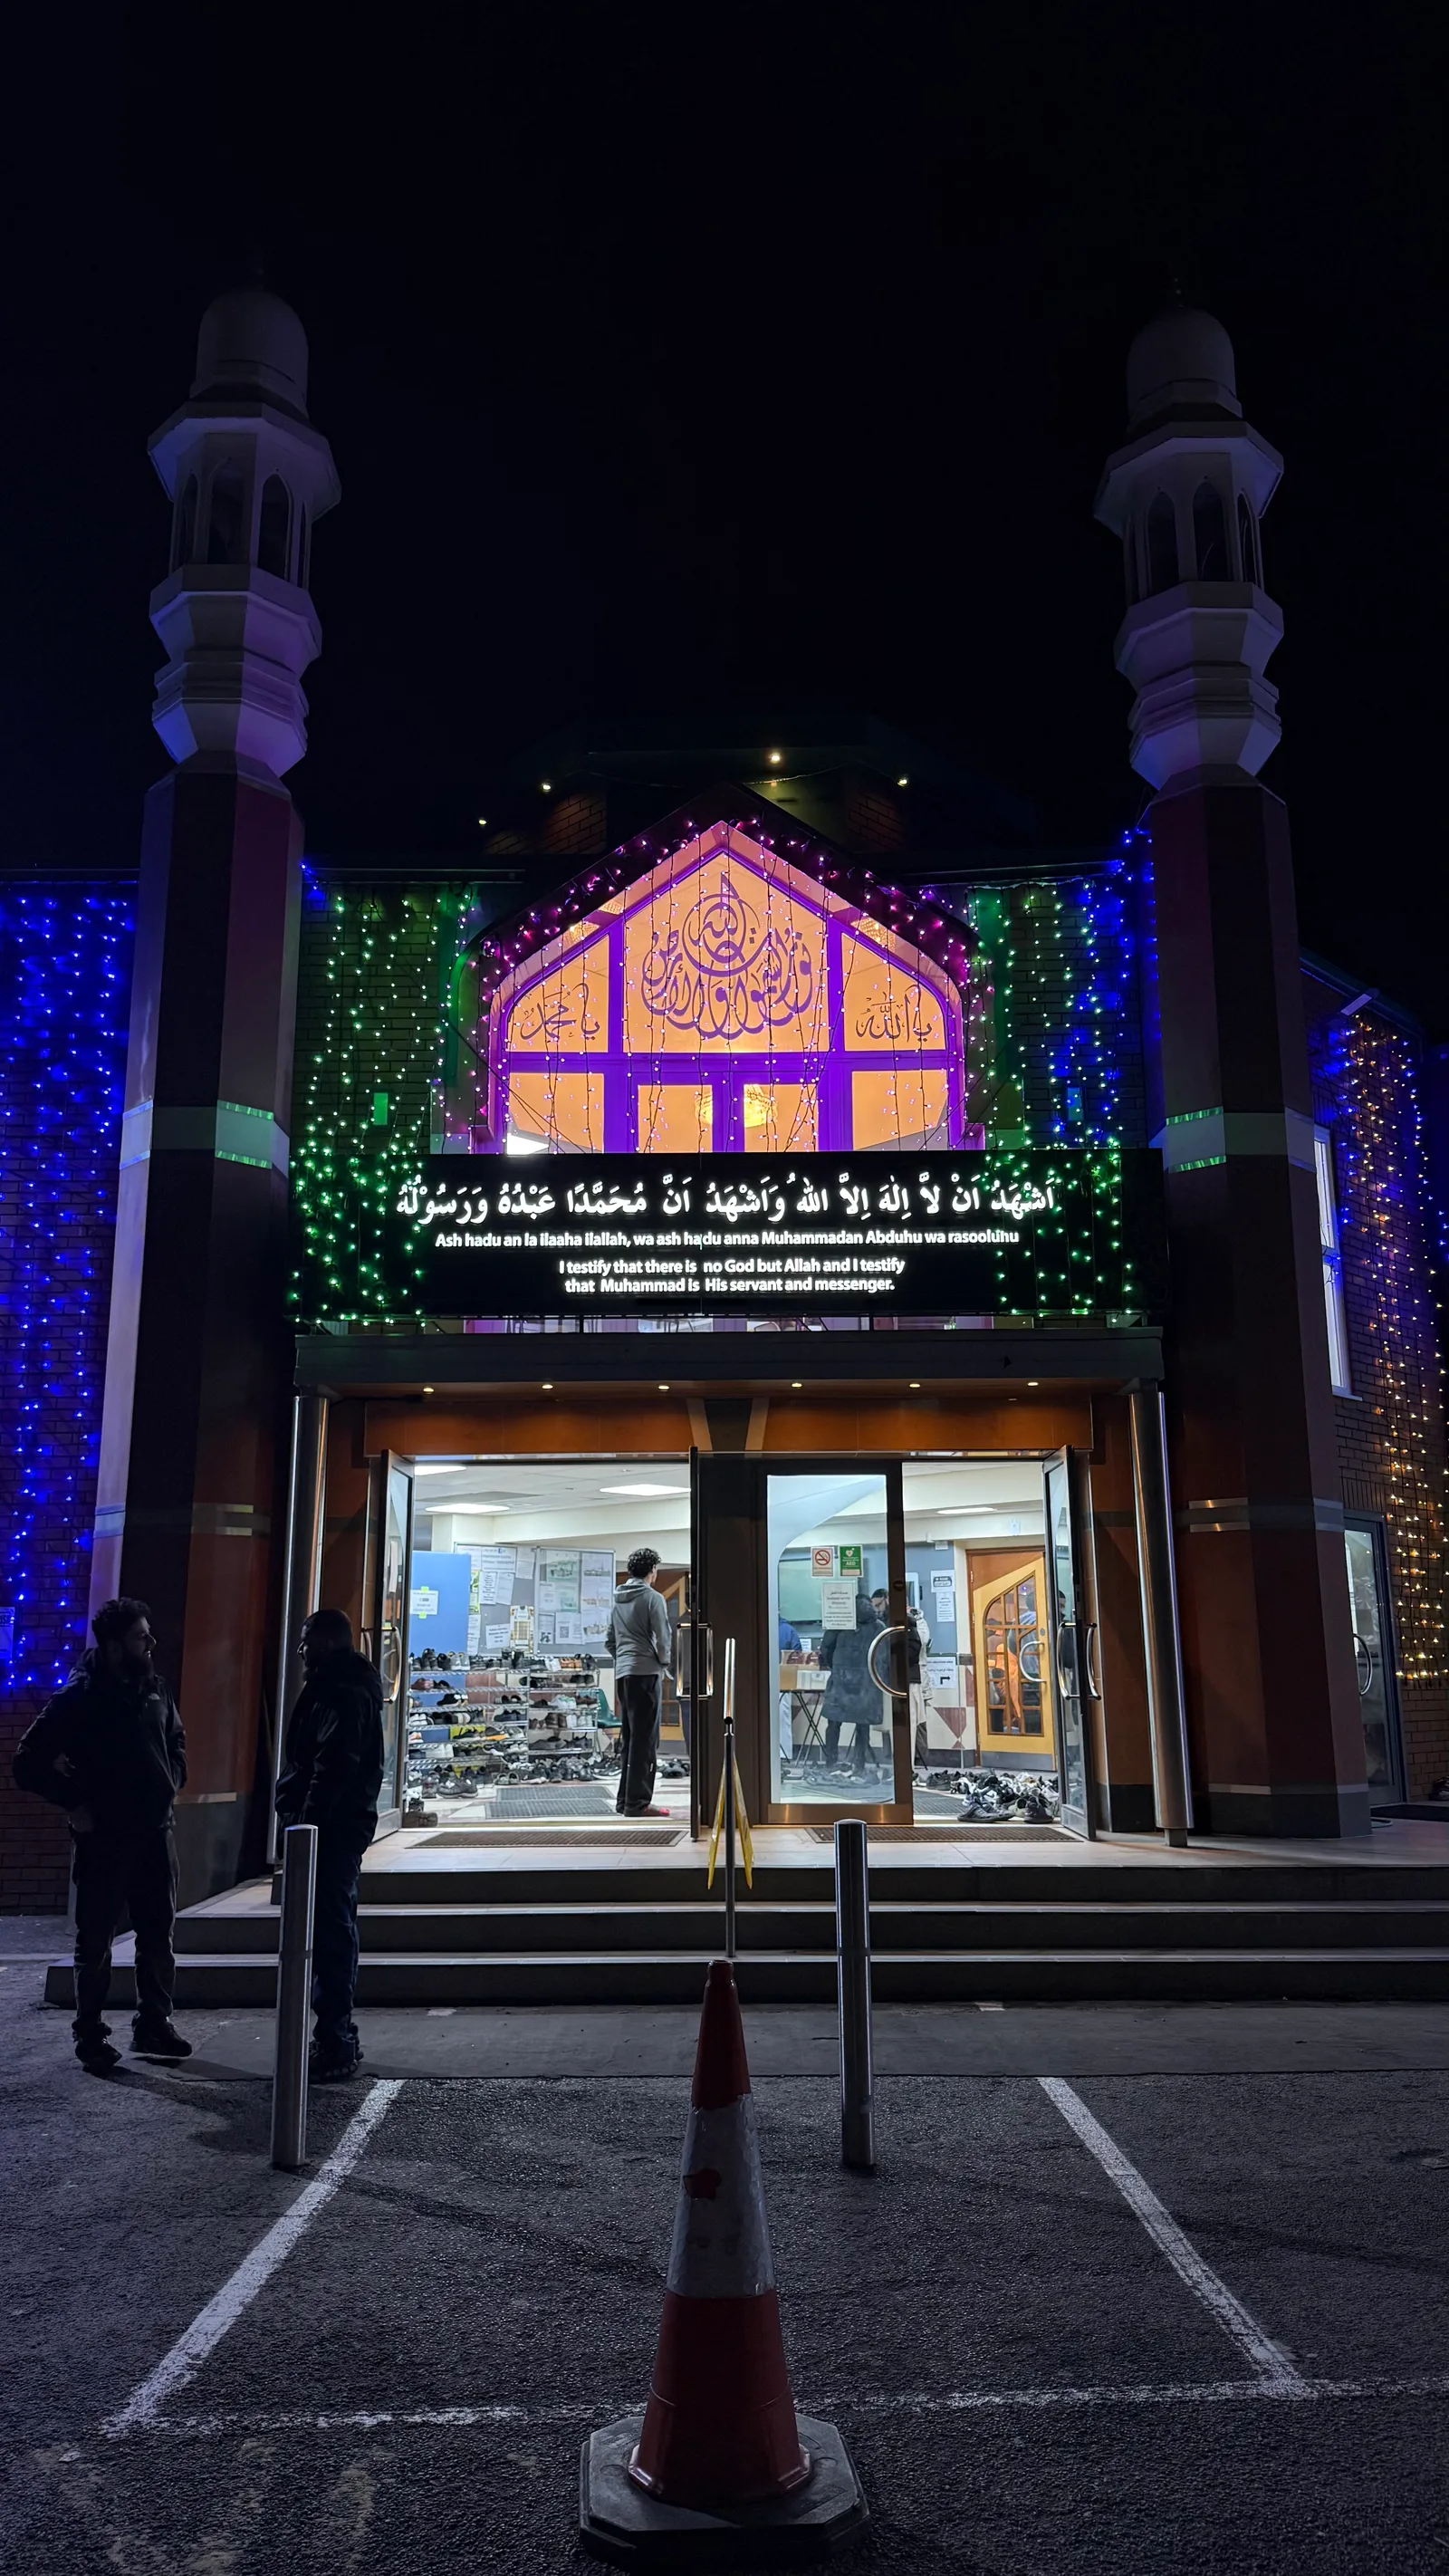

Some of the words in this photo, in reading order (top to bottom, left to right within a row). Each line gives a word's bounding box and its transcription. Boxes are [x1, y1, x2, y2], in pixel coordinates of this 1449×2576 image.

[436, 1233, 462, 1247] Ash
[465, 1233, 502, 1247] hadu
[504, 1235, 523, 1247] an
[524, 1232, 538, 1247] la
[540, 1232, 583, 1247] ilaaha
[633, 1235, 655, 1246] wa
[657, 1232, 681, 1246] ash
[684, 1231, 722, 1246] hadu
[724, 1234, 760, 1245] anna
[762, 1230, 864, 1245] Muhammadan
[866, 1229, 923, 1245] Abduhu
[925, 1232, 946, 1244] wa
[559, 1260, 565, 1274] I
[566, 1259, 611, 1277] testify
[613, 1259, 644, 1274] that
[645, 1259, 684, 1274] there
[685, 1259, 698, 1273] is
[703, 1261, 724, 1273] no
[724, 1258, 755, 1273] God
[757, 1258, 782, 1273] but
[783, 1257, 820, 1273] Allah
[822, 1257, 850, 1272] and
[852, 1258, 859, 1272] I
[859, 1257, 906, 1275] testify
[565, 1278, 596, 1293] that
[600, 1278, 686, 1293] Muhammad
[687, 1278, 701, 1292] is
[705, 1278, 728, 1292] His
[729, 1278, 783, 1292] servant
[784, 1277, 813, 1292] and
[815, 1279, 896, 1293] messenger.
